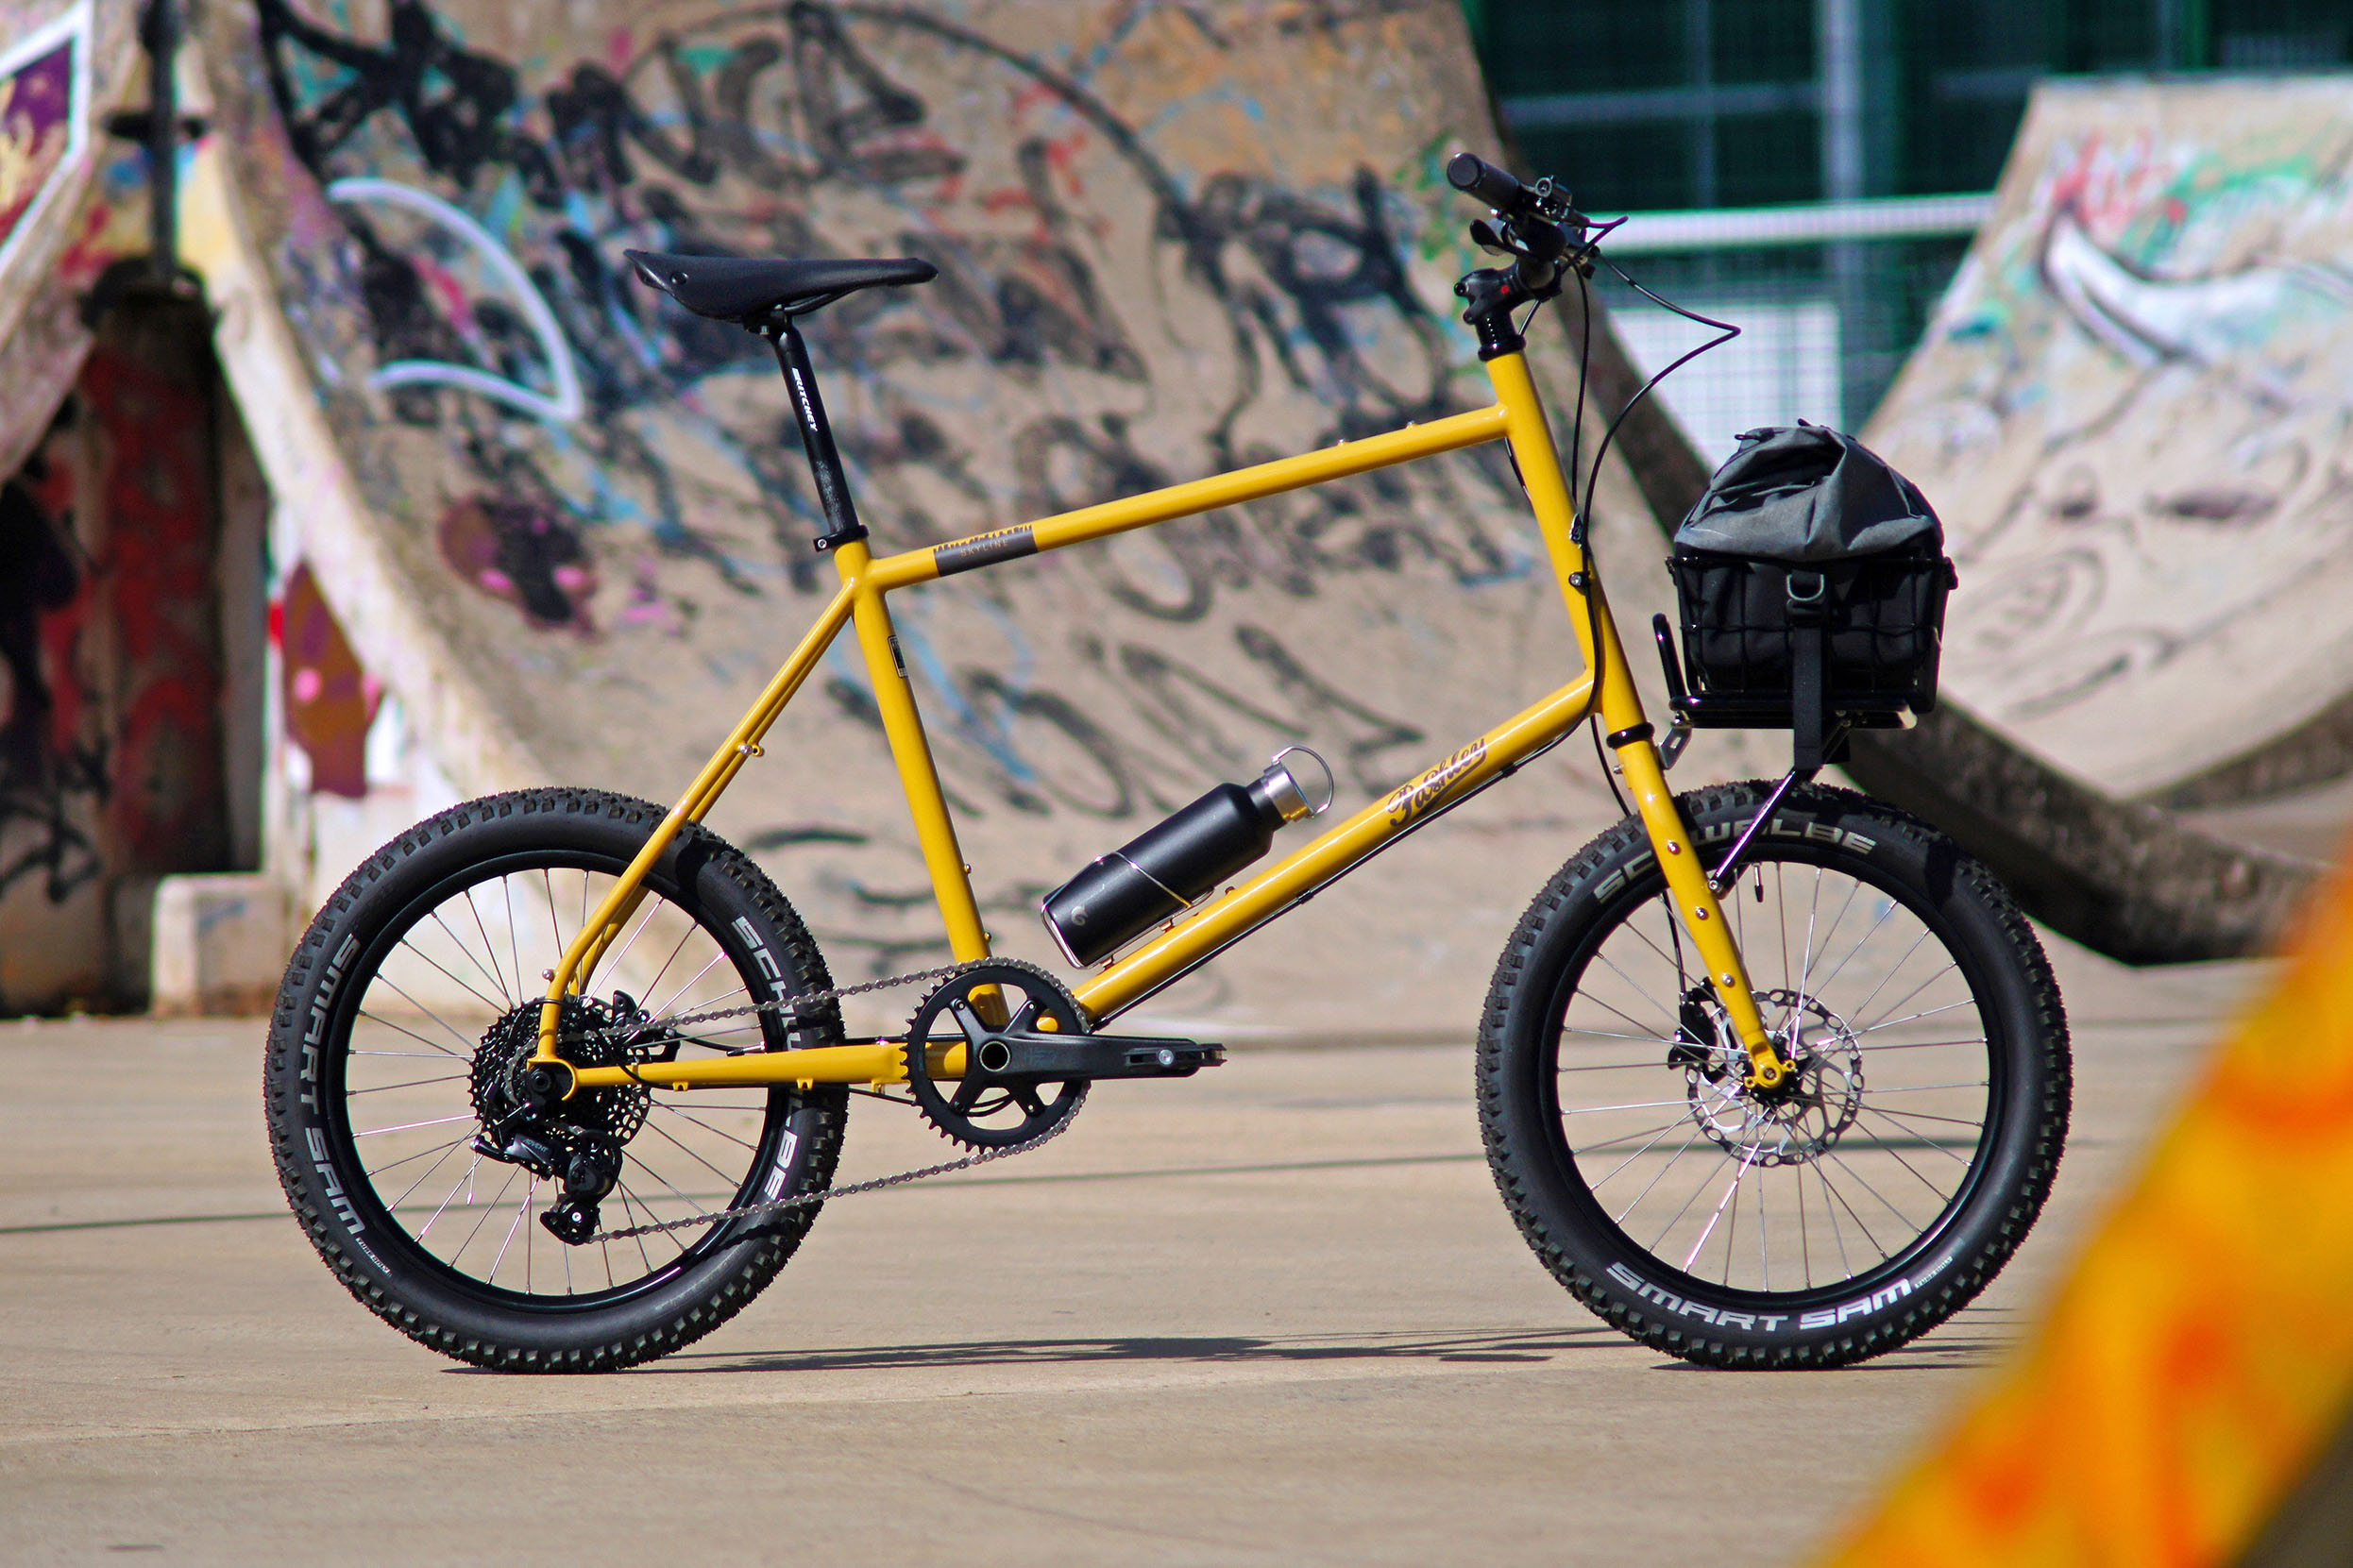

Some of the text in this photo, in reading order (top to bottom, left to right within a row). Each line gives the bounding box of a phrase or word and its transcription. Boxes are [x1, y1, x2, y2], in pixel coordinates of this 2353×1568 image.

[795, 379, 819, 431] RITCHEY
[960, 538, 1009, 557] SKYLINE
[1593, 818, 1878, 903] SCWLBE
[299, 933, 366, 1236] SMART SAM
[731, 915, 804, 1201] SCHWLBE
[1606, 1261, 1912, 1332] SMART SAM
